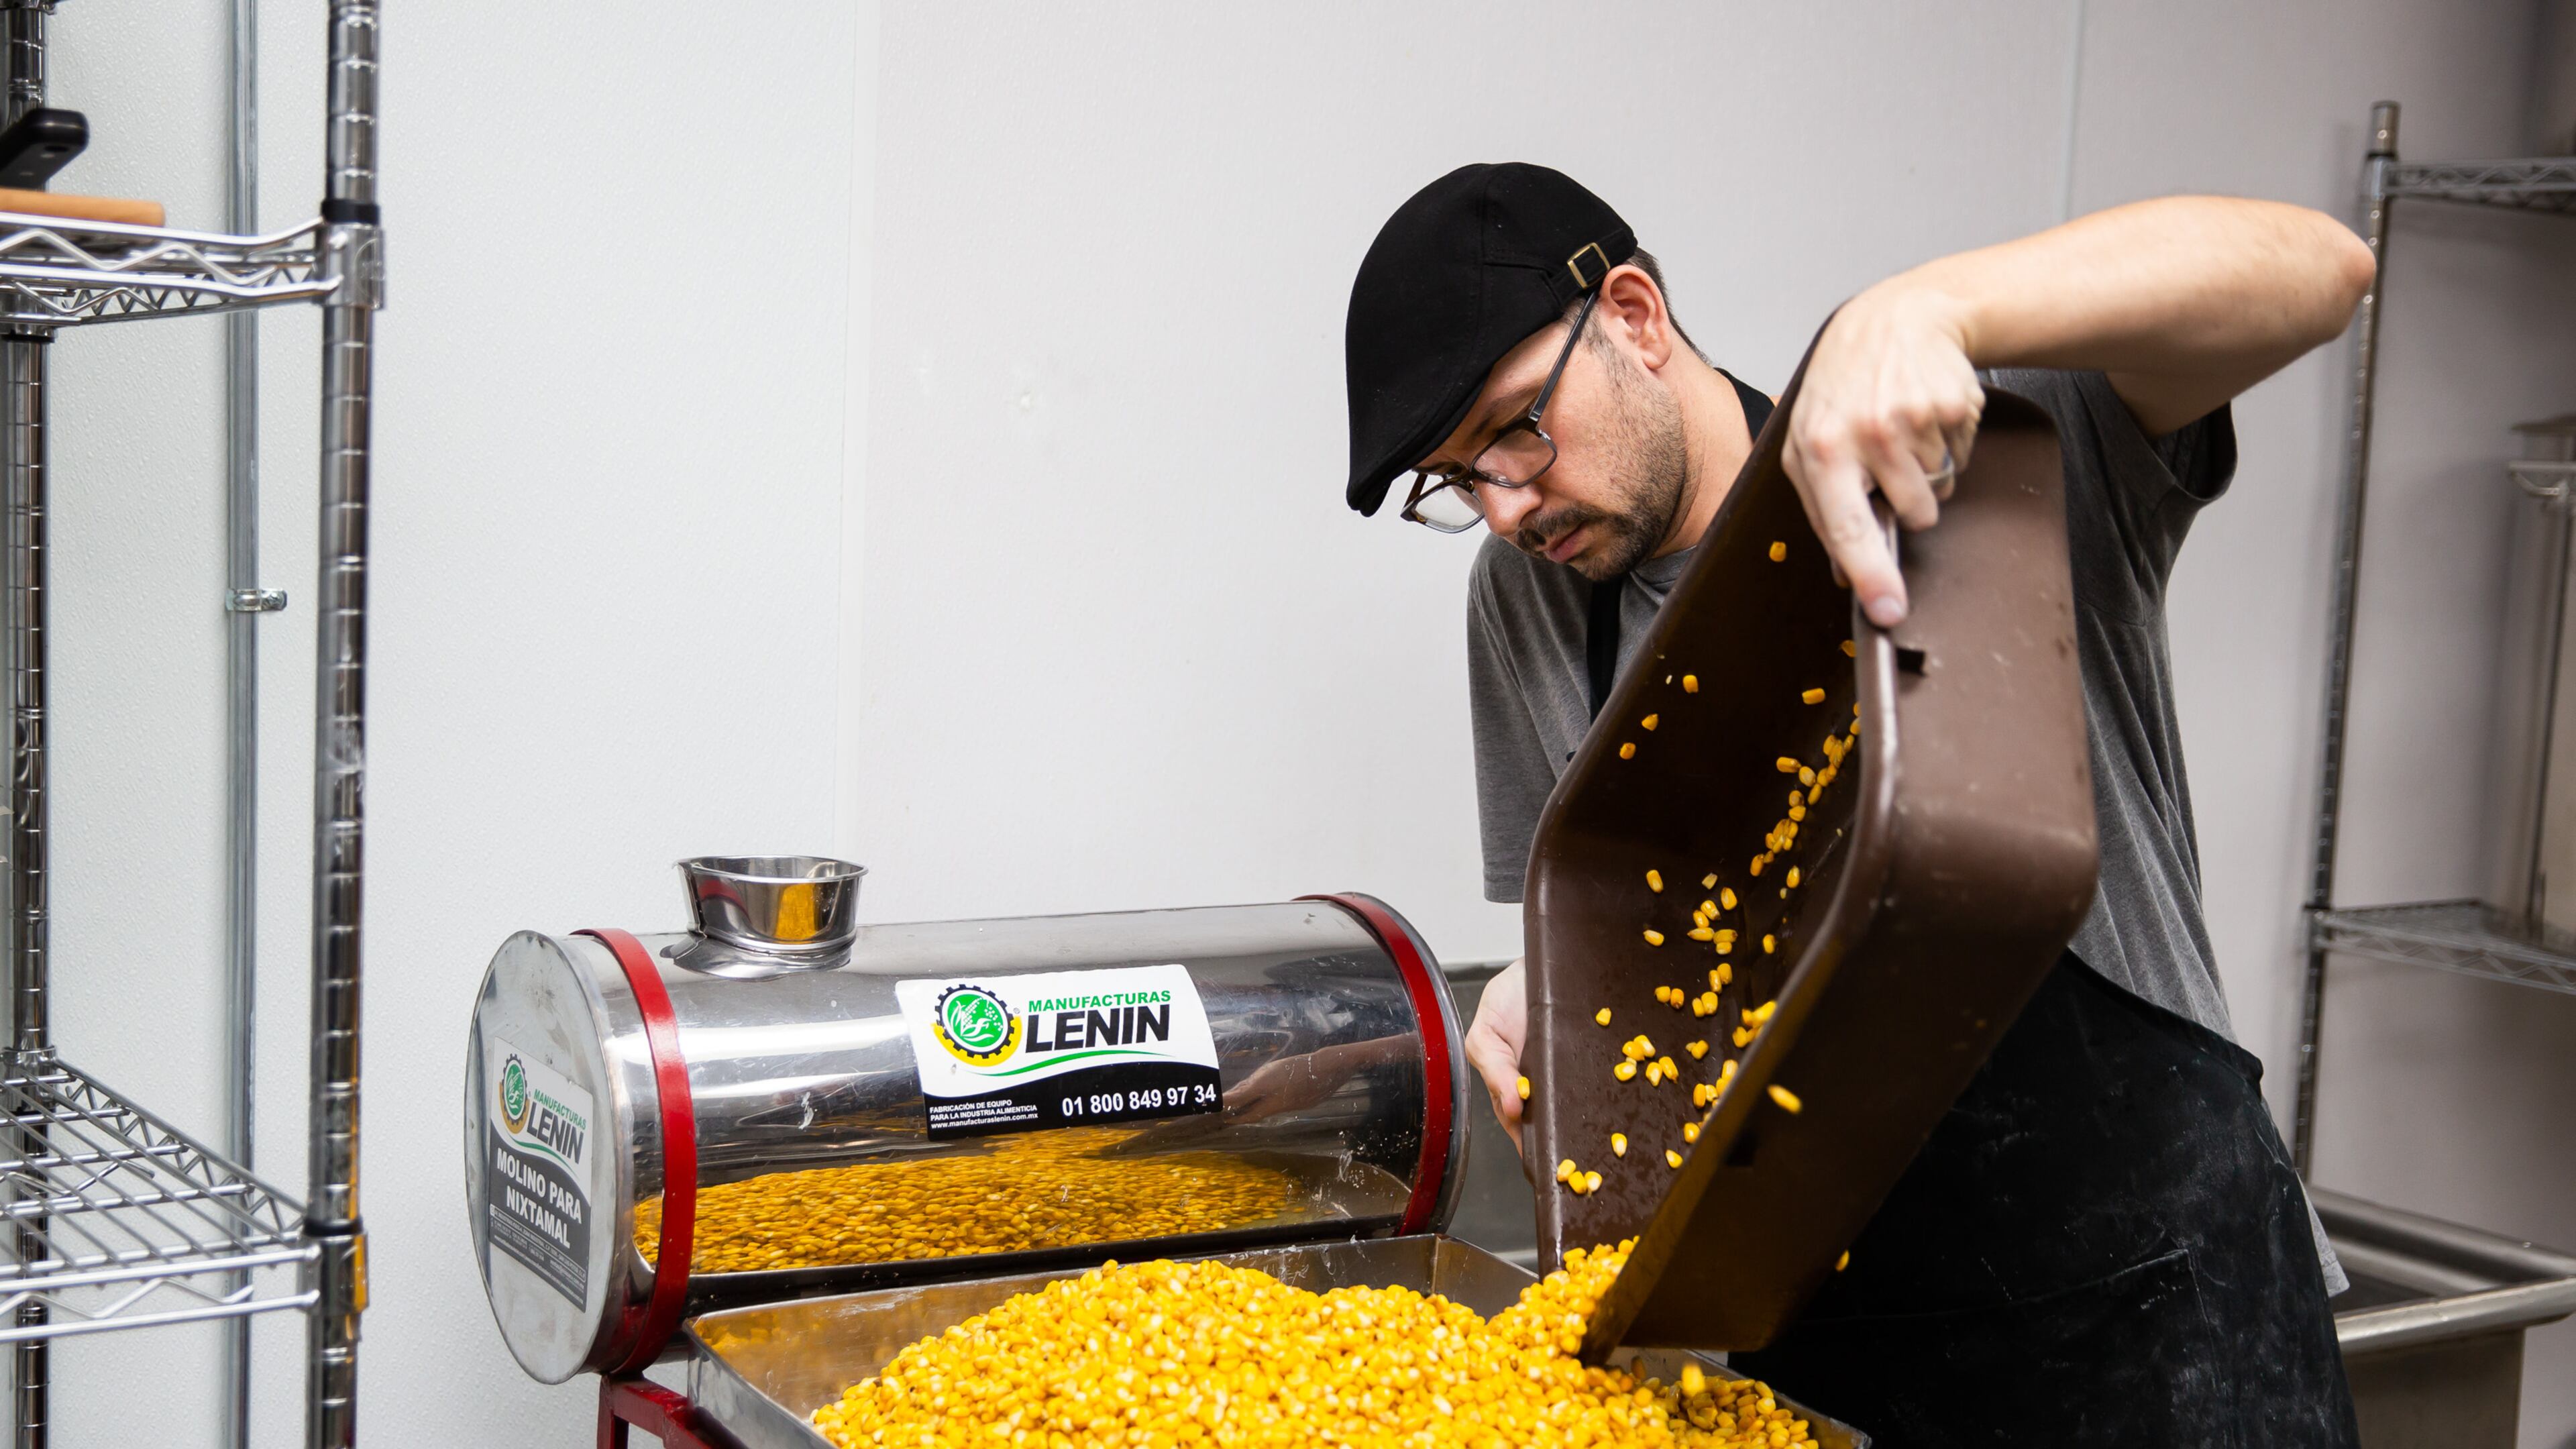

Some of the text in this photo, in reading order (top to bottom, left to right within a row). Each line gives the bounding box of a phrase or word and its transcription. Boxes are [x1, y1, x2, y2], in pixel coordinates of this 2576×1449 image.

[1028, 990, 1171, 1012] MANUFACTURAS
[1026, 1004, 1170, 1053] LENIN
[534, 1089, 586, 1130] MANUFACTURAS
[930, 1102, 976, 1114] FABRICACIÓN
[986, 1099, 1012, 1108] EQUIPO
[960, 1109, 996, 1118] INDUSTRIA
[996, 1105, 1037, 1114] ALIMENTICIA
[1062, 1083, 1216, 1116] 01 800 849 97 34
[527, 1102, 584, 1165] LENIN
[931, 1113, 1038, 1128] www.manufacturaslenin.com.mx
[497, 1148, 582, 1224] MOLINO PARA
[506, 1185, 570, 1248] NIXTAMAL
